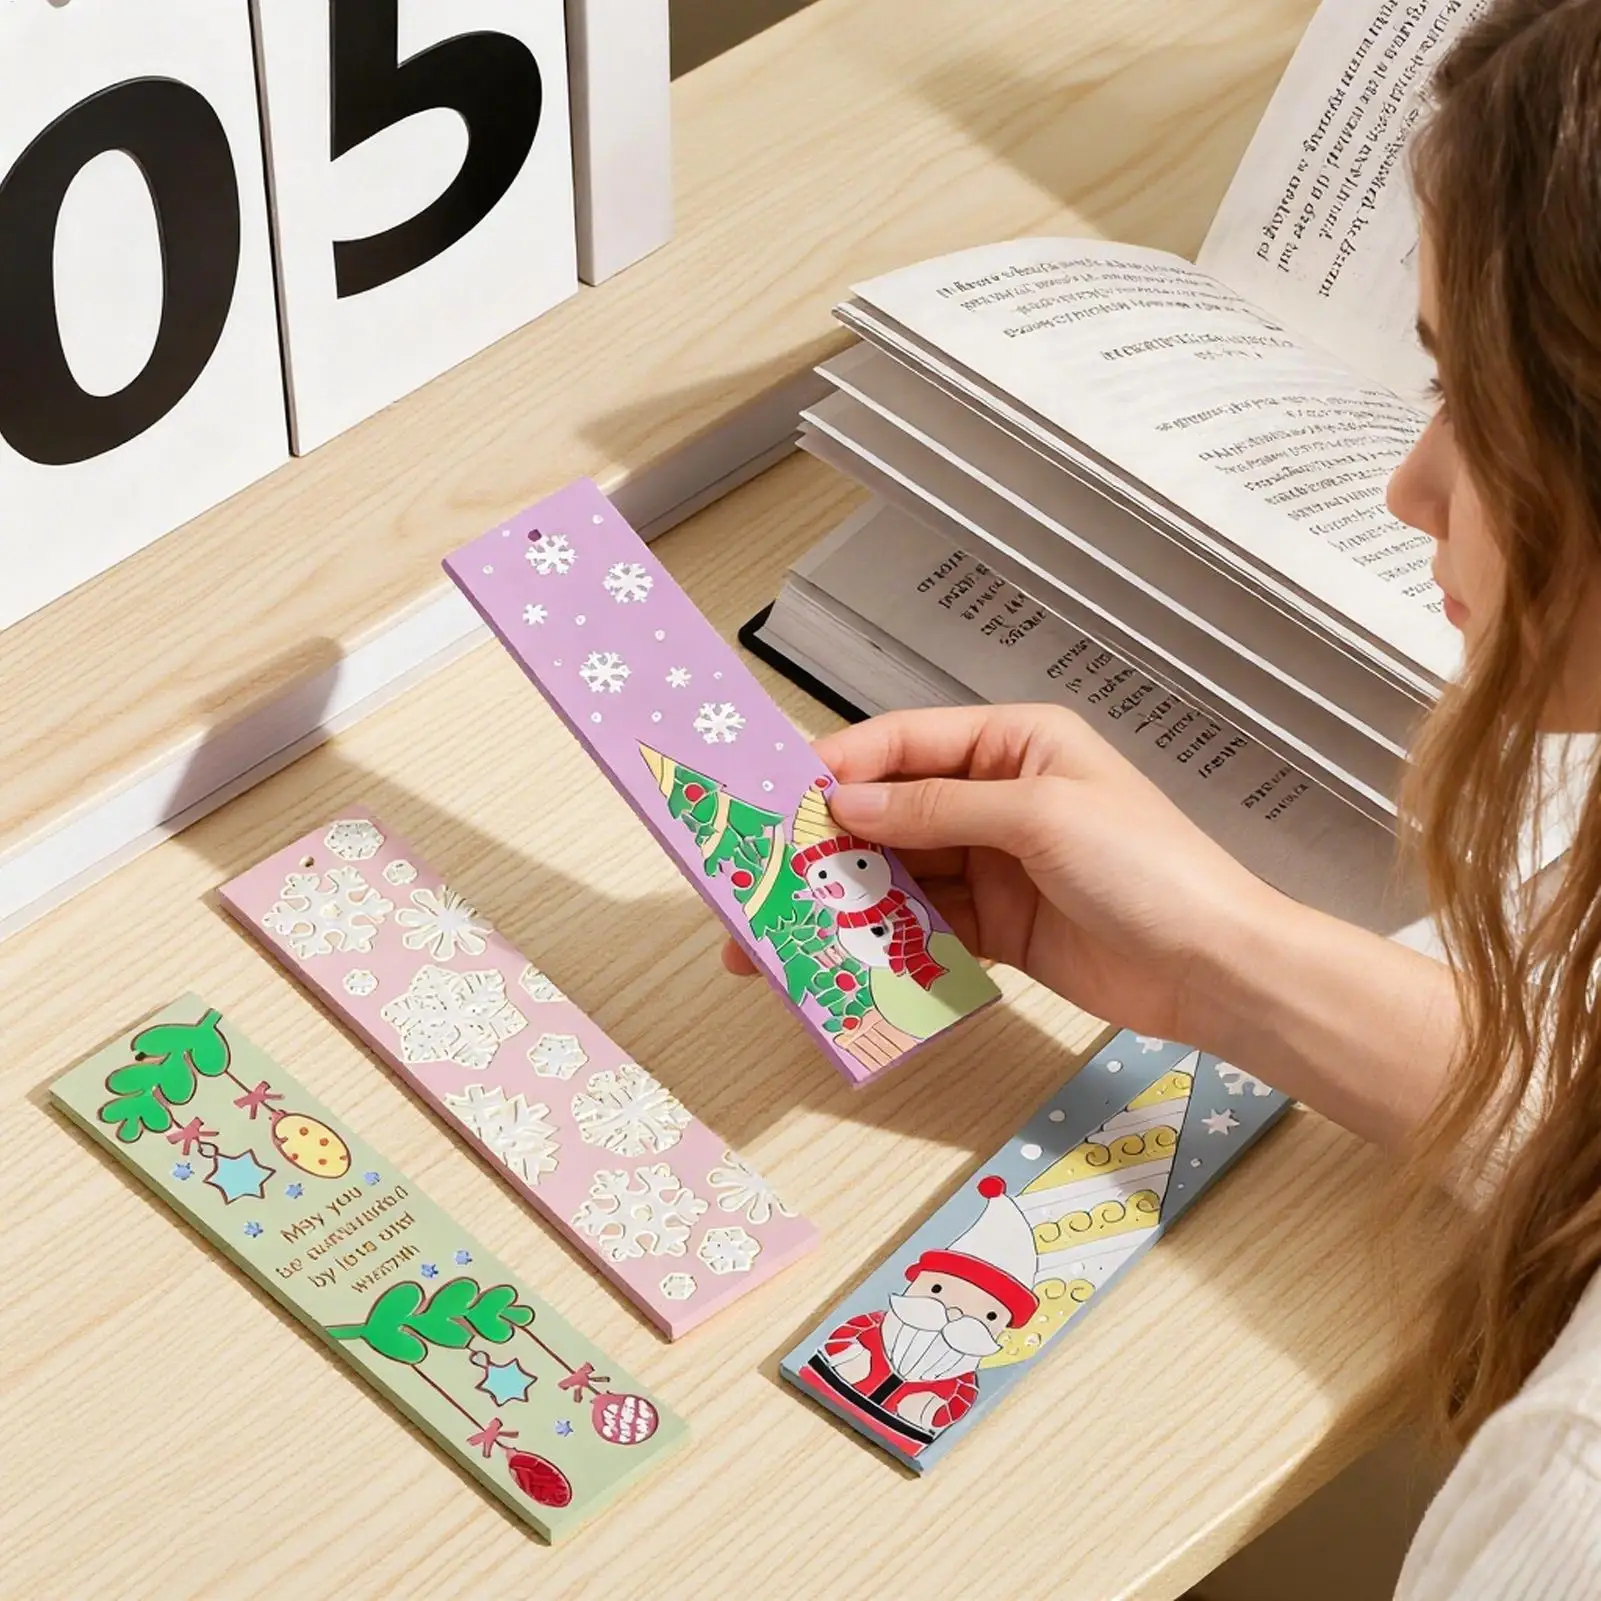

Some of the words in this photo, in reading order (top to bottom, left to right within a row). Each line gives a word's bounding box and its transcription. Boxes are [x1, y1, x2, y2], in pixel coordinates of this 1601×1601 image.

[0, 0, 543, 466] 05
[280, 1212, 325, 1244] May
[326, 1187, 363, 1216] you
[308, 1267, 337, 1288] by
